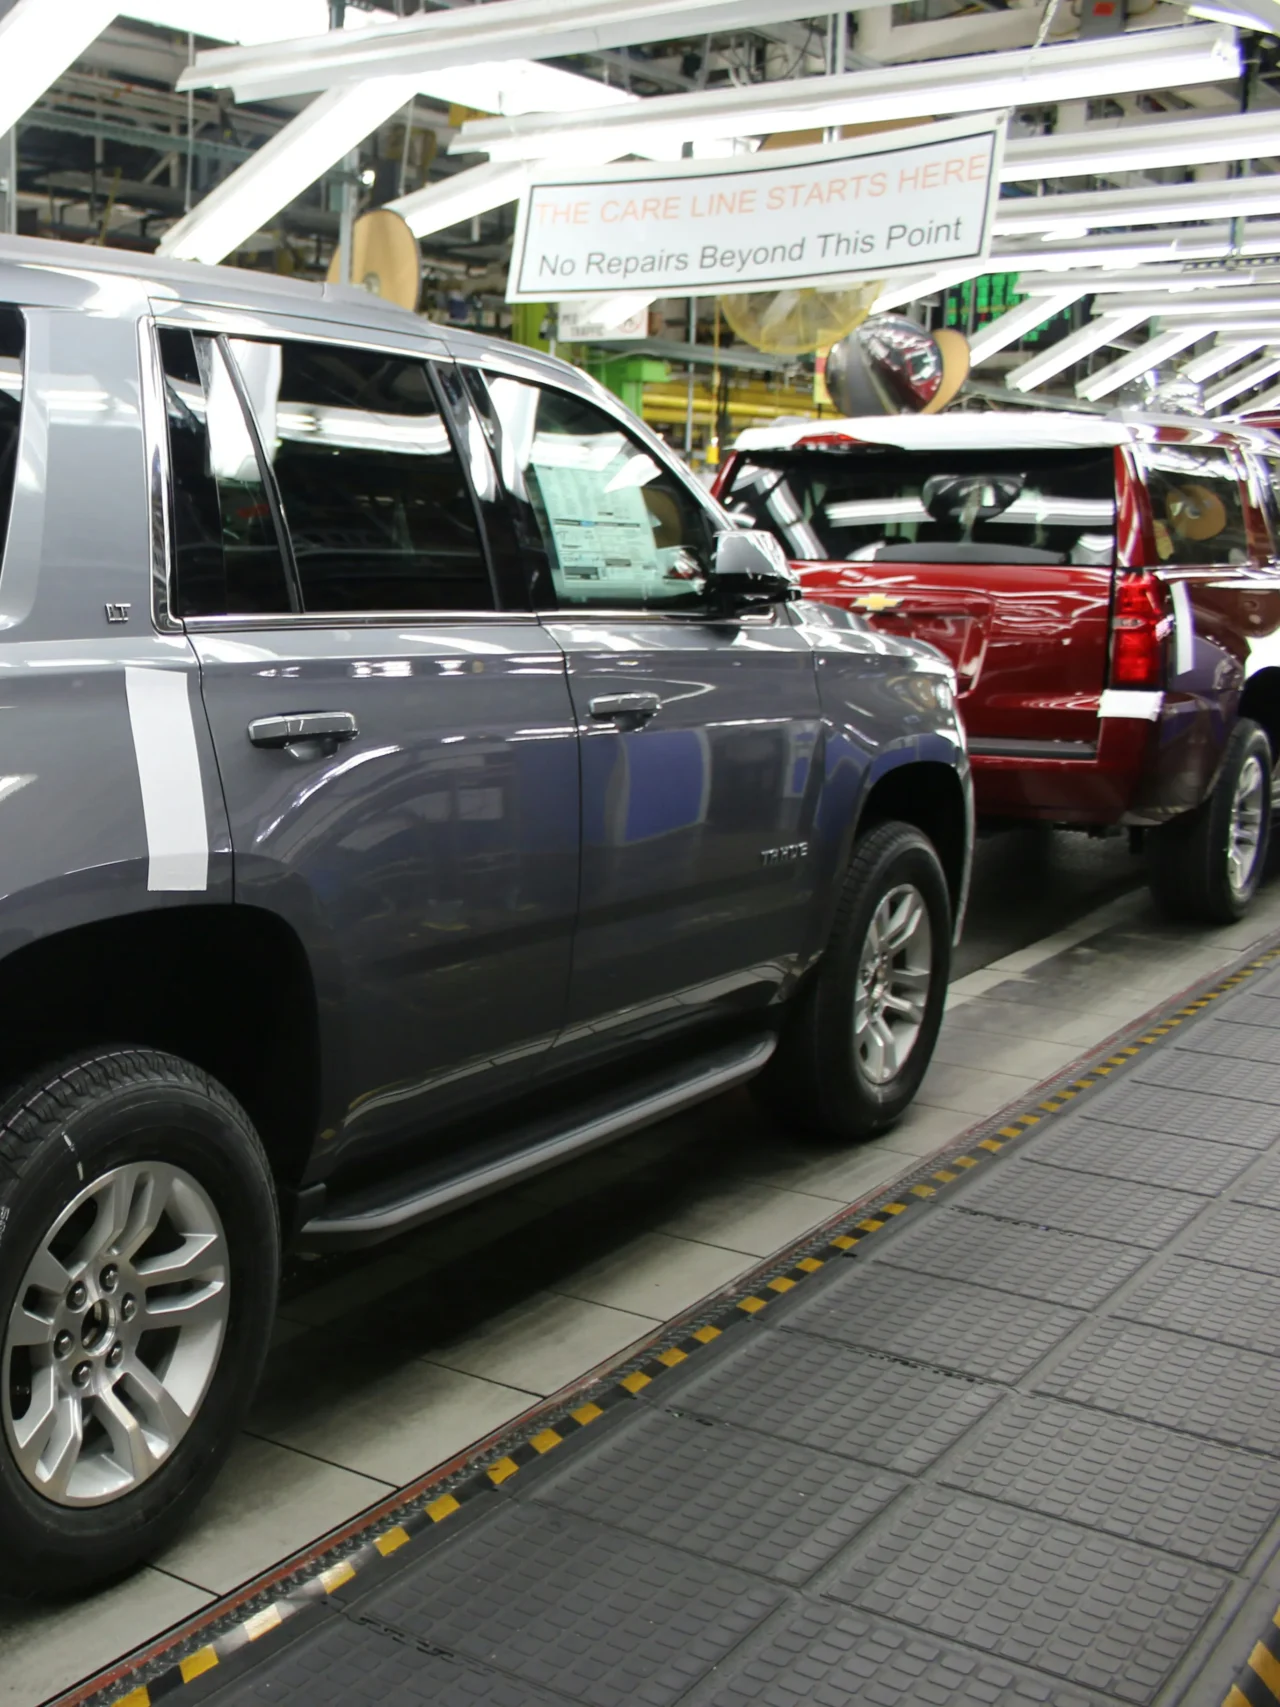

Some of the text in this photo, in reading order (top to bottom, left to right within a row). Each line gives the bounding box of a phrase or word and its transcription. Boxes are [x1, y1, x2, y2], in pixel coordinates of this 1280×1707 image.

[535, 154, 988, 225] THE CARE LINE STARTS HERE
[539, 216, 963, 279] No Repairs Beyond This Point
[105, 603, 131, 624] LT
